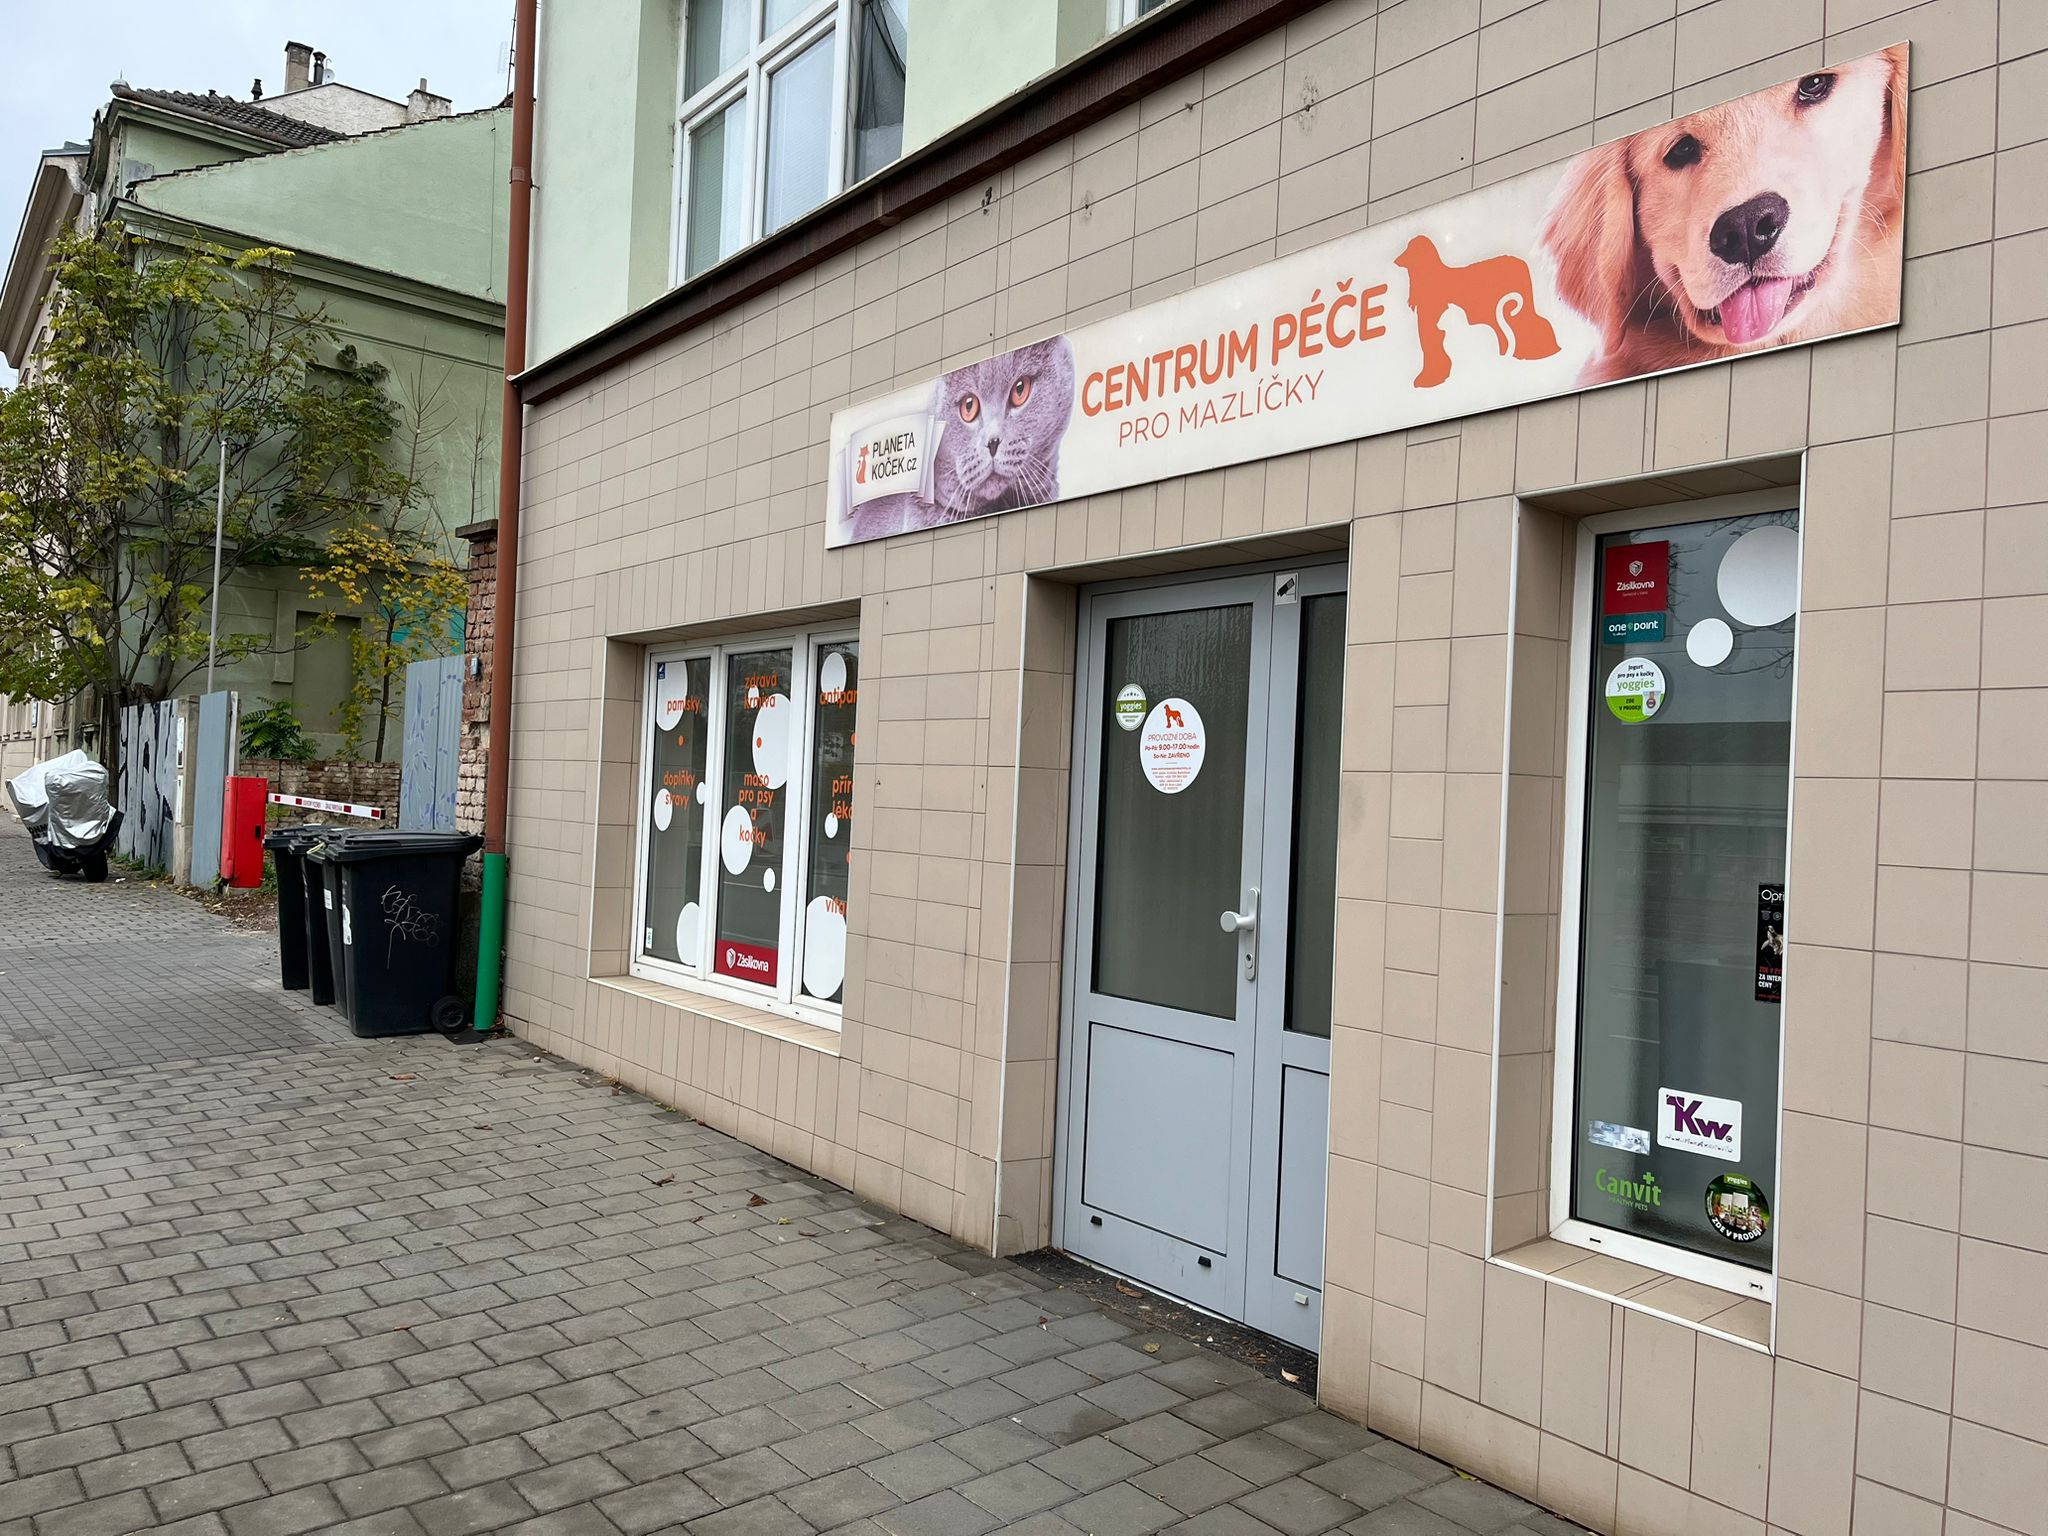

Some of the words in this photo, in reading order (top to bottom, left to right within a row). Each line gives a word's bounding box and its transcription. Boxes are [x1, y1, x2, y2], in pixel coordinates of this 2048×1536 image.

[1081, 323, 1259, 418] CENTRUM
[1271, 276, 1389, 367] PÉČE
[1118, 411, 1171, 448] PRO
[1178, 369, 1325, 434] MAZLÍČKY
[872, 431, 916, 459] PLANETA
[871, 456, 918, 481] KOČEK.cz
[1616, 580, 1656, 592] Zásilkovna
[1608, 623, 1627, 632] one
[1633, 620, 1659, 632] point
[744, 672, 778, 689] zdravá
[1616, 679, 1656, 692] yoggies
[666, 697, 702, 715] pamlsky
[743, 691, 776, 710] krmiva
[1119, 702, 1142, 712] yoggies
[1147, 733, 1178, 741] PROVOZNÍ
[1178, 732, 1197, 740] DOBA
[663, 769, 695, 789] doplňky
[743, 773, 770, 788] maso
[665, 792, 688, 809] stravy
[738, 789, 755, 806] pro
[757, 790, 774, 808] psy
[750, 807, 757, 821] a
[739, 824, 767, 849] kočky
[736, 952, 770, 973] Zásilkovna
[1595, 1168, 1662, 1206] Canvit
[1634, 1202, 1648, 1211] PETS
[1711, 1217, 1726, 1233] ZDE
[1726, 1229, 1732, 1237] V
